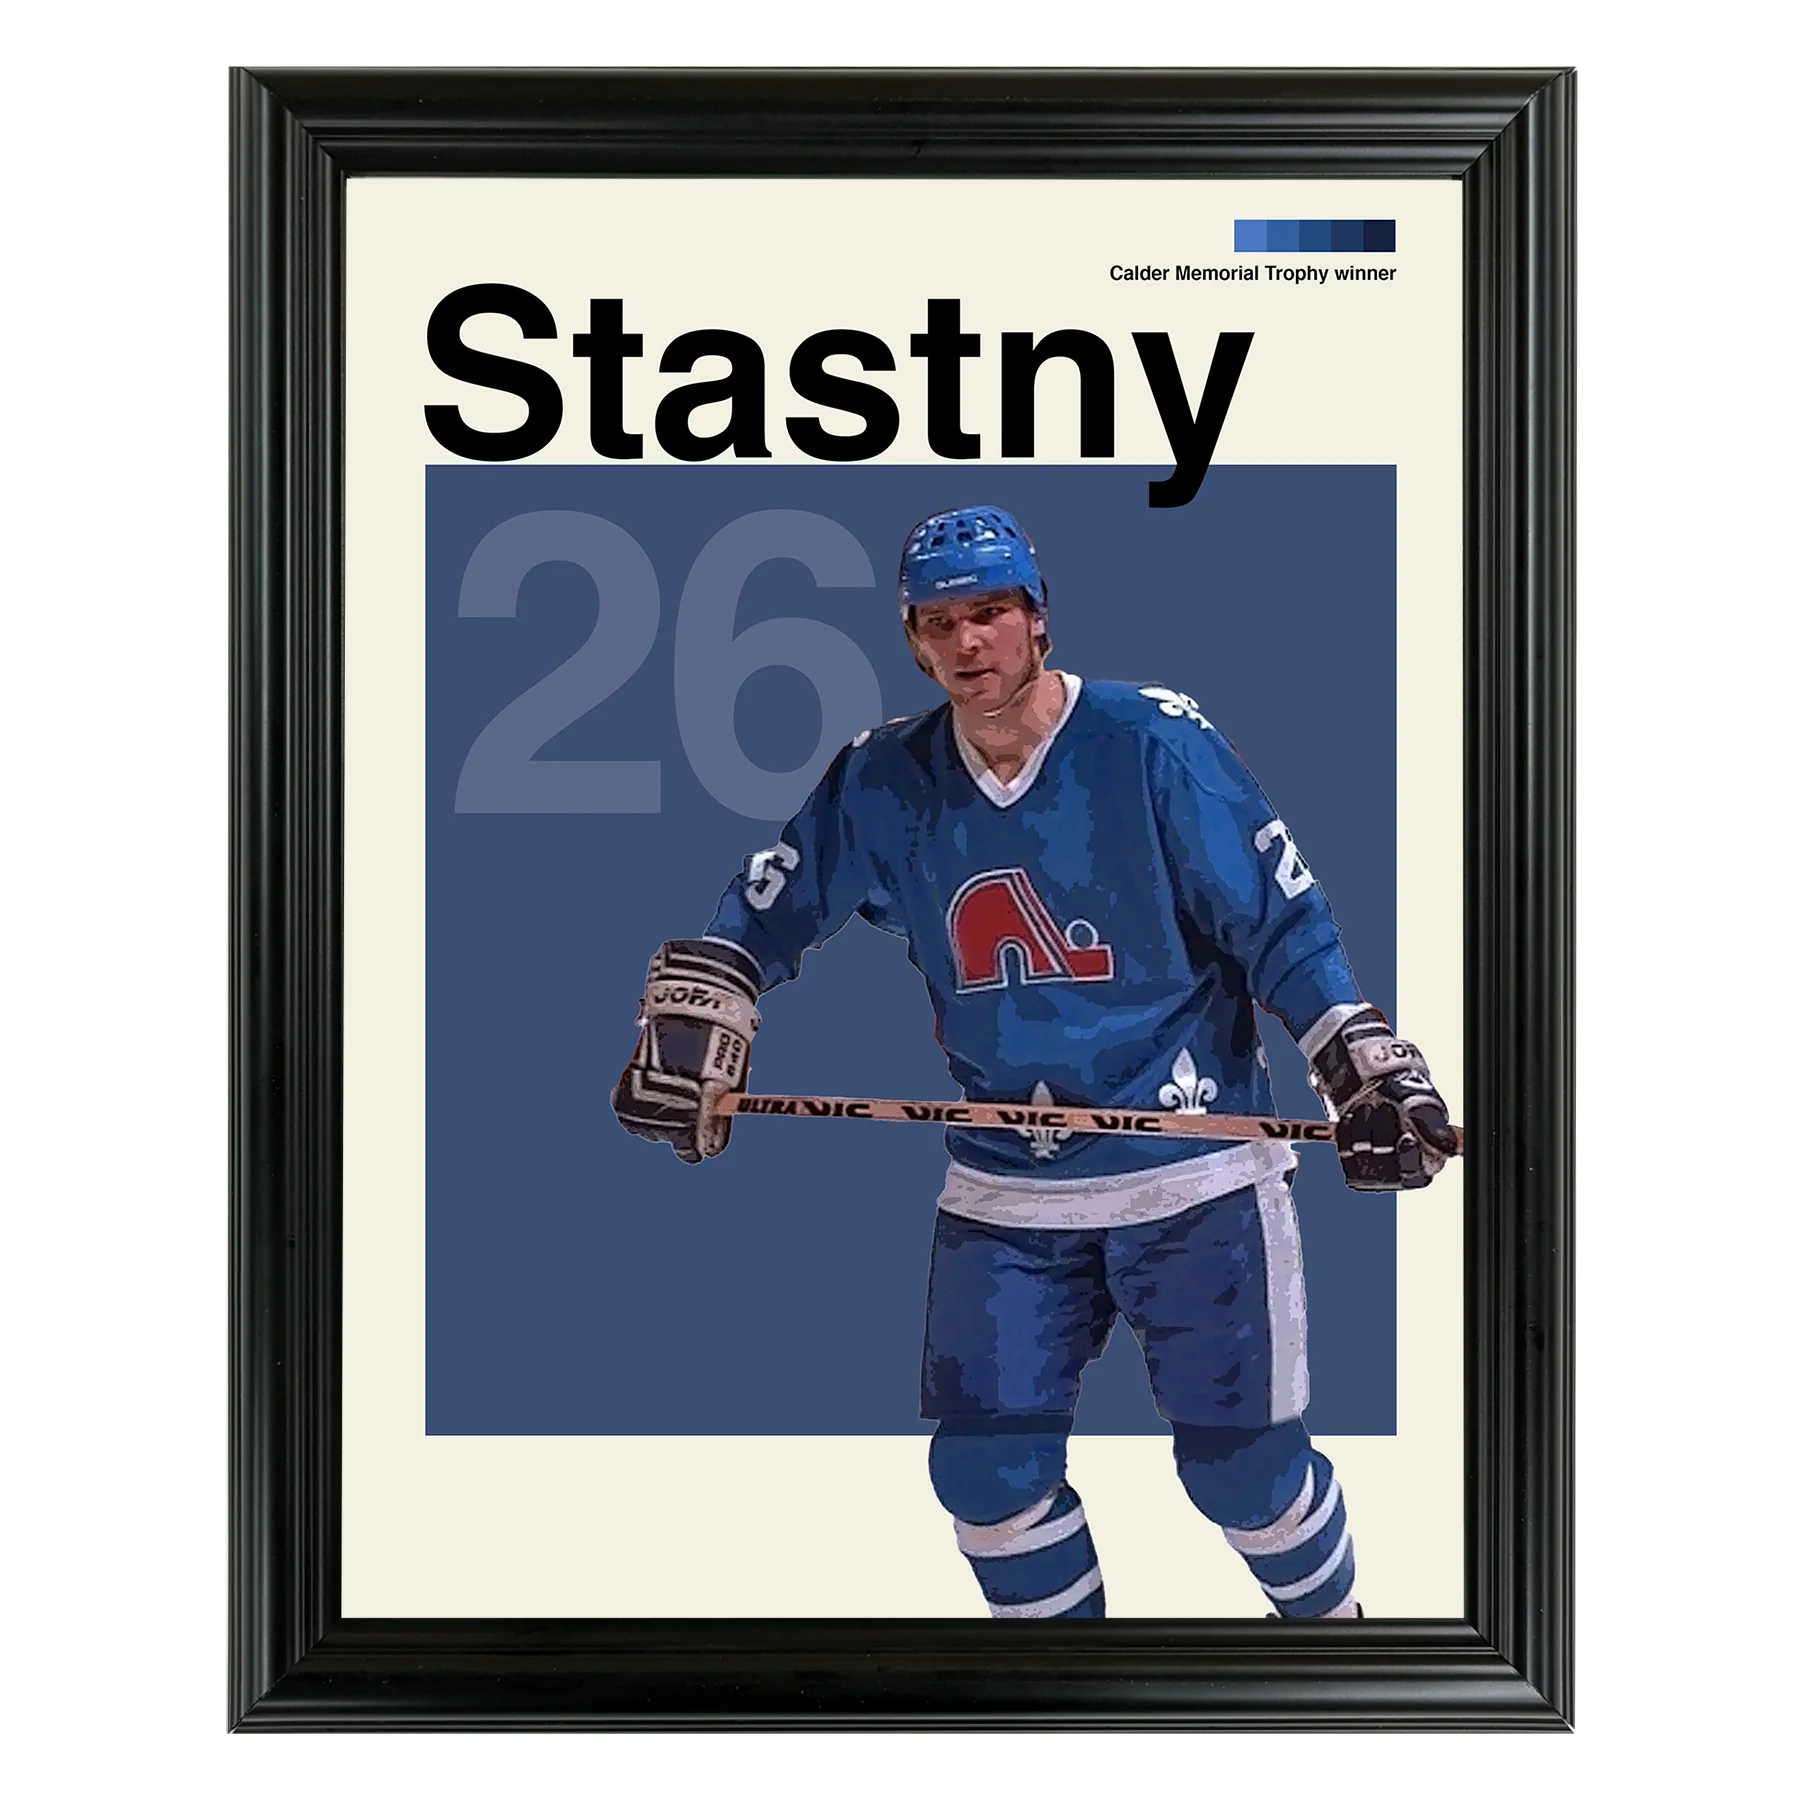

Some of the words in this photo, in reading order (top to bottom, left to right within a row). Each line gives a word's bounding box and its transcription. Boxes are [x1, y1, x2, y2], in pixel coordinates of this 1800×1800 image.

[1109, 265, 1169, 281] Calder
[1175, 265, 1259, 281] Memorial
[1264, 265, 1329, 285] Trophy
[1335, 265, 1397, 281] winner
[425, 283, 1254, 508] Stastny
[454, 509, 883, 822] 26
[737, 1098, 797, 1115] ULTRA
[802, 1099, 873, 1118] VIC
[901, 1105, 973, 1122] VIC
[997, 1110, 1068, 1127] VIC
[1091, 1114, 1162, 1132] VIC
[1259, 1121, 1333, 1140] VIC
